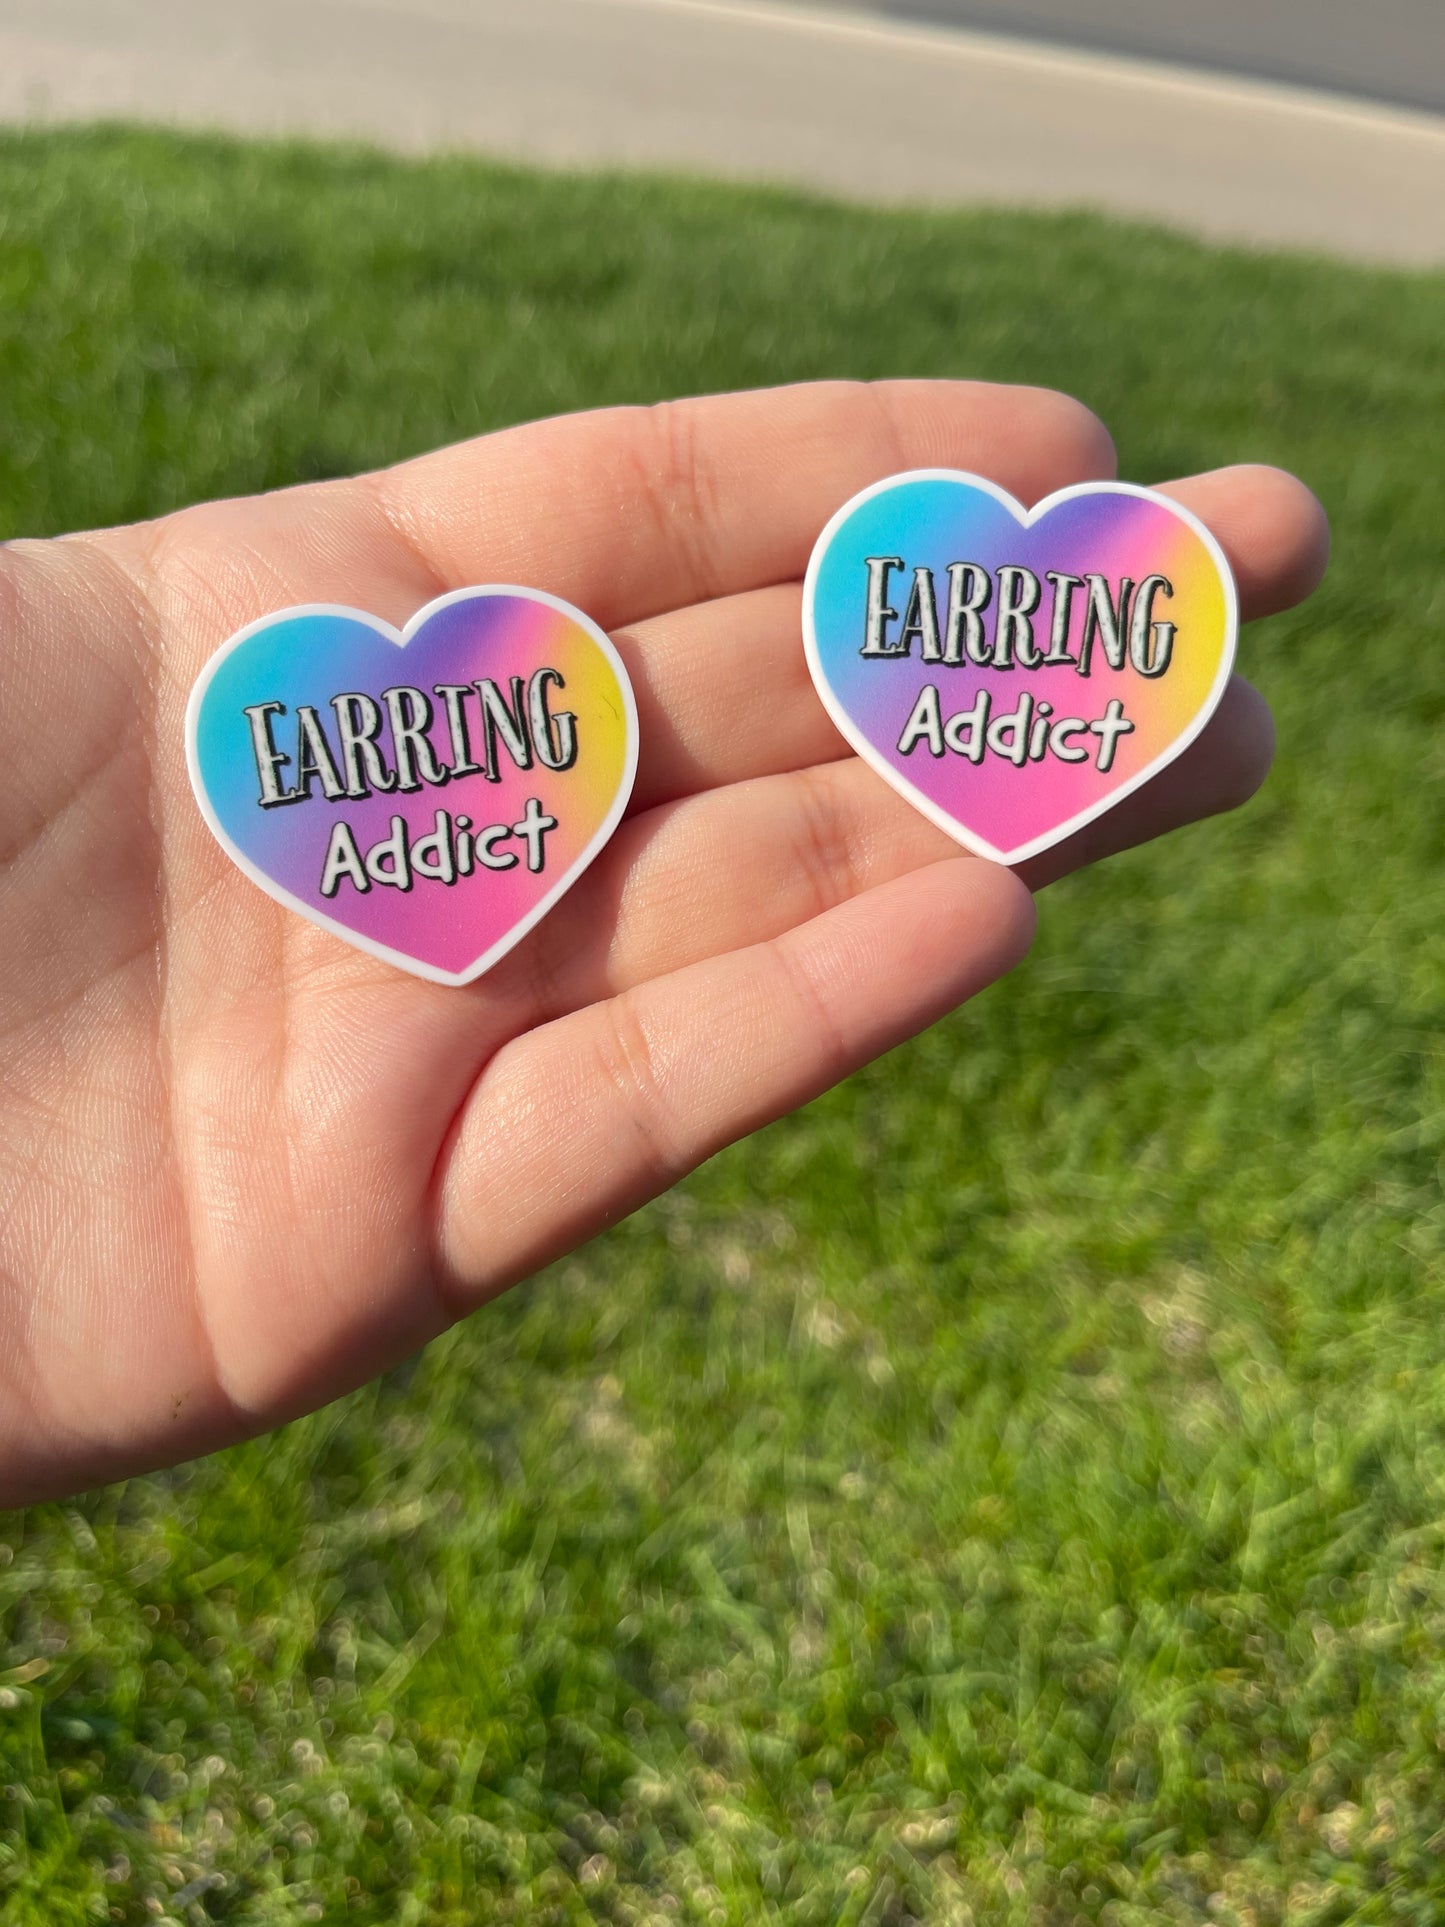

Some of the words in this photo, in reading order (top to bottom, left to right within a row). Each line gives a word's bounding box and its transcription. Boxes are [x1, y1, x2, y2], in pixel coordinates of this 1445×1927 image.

[859, 556, 1178, 679] EARRING
[243, 668, 578, 808] EARRING
[897, 685, 1135, 773] Addict
[319, 798, 558, 898] Addict
